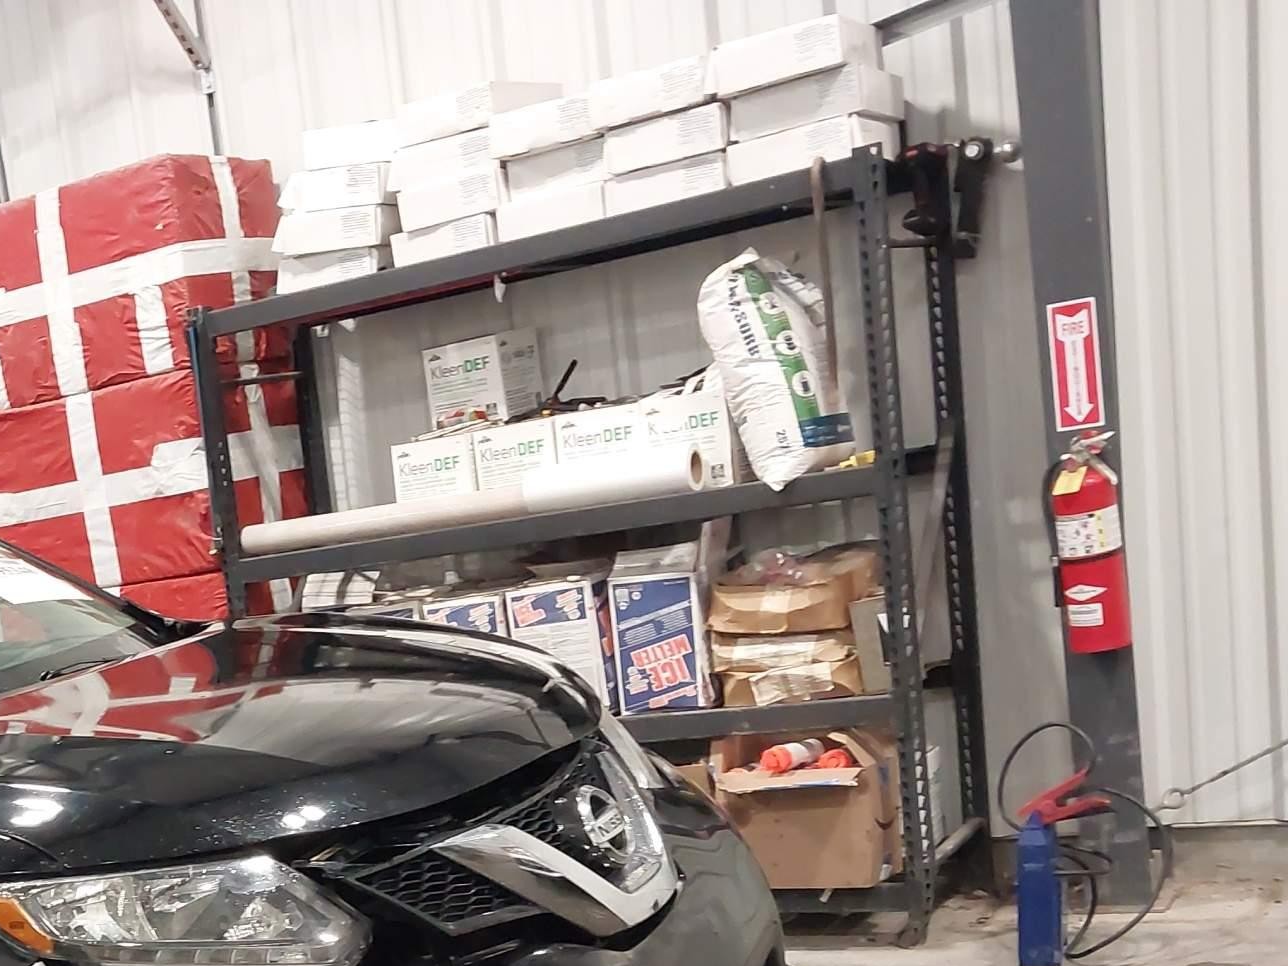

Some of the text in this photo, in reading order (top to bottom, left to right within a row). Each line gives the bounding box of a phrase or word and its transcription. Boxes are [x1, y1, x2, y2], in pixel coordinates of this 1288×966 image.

[1061, 320, 1085, 335] FIRE
[430, 355, 490, 380] KleenDEF
[562, 425, 632, 450] KleenDEF
[479, 438, 545, 463] KleenDEF
[398, 455, 460, 478] KleenDEF
[632, 635, 691, 668] MELTER
[647, 657, 690, 691] ICE
